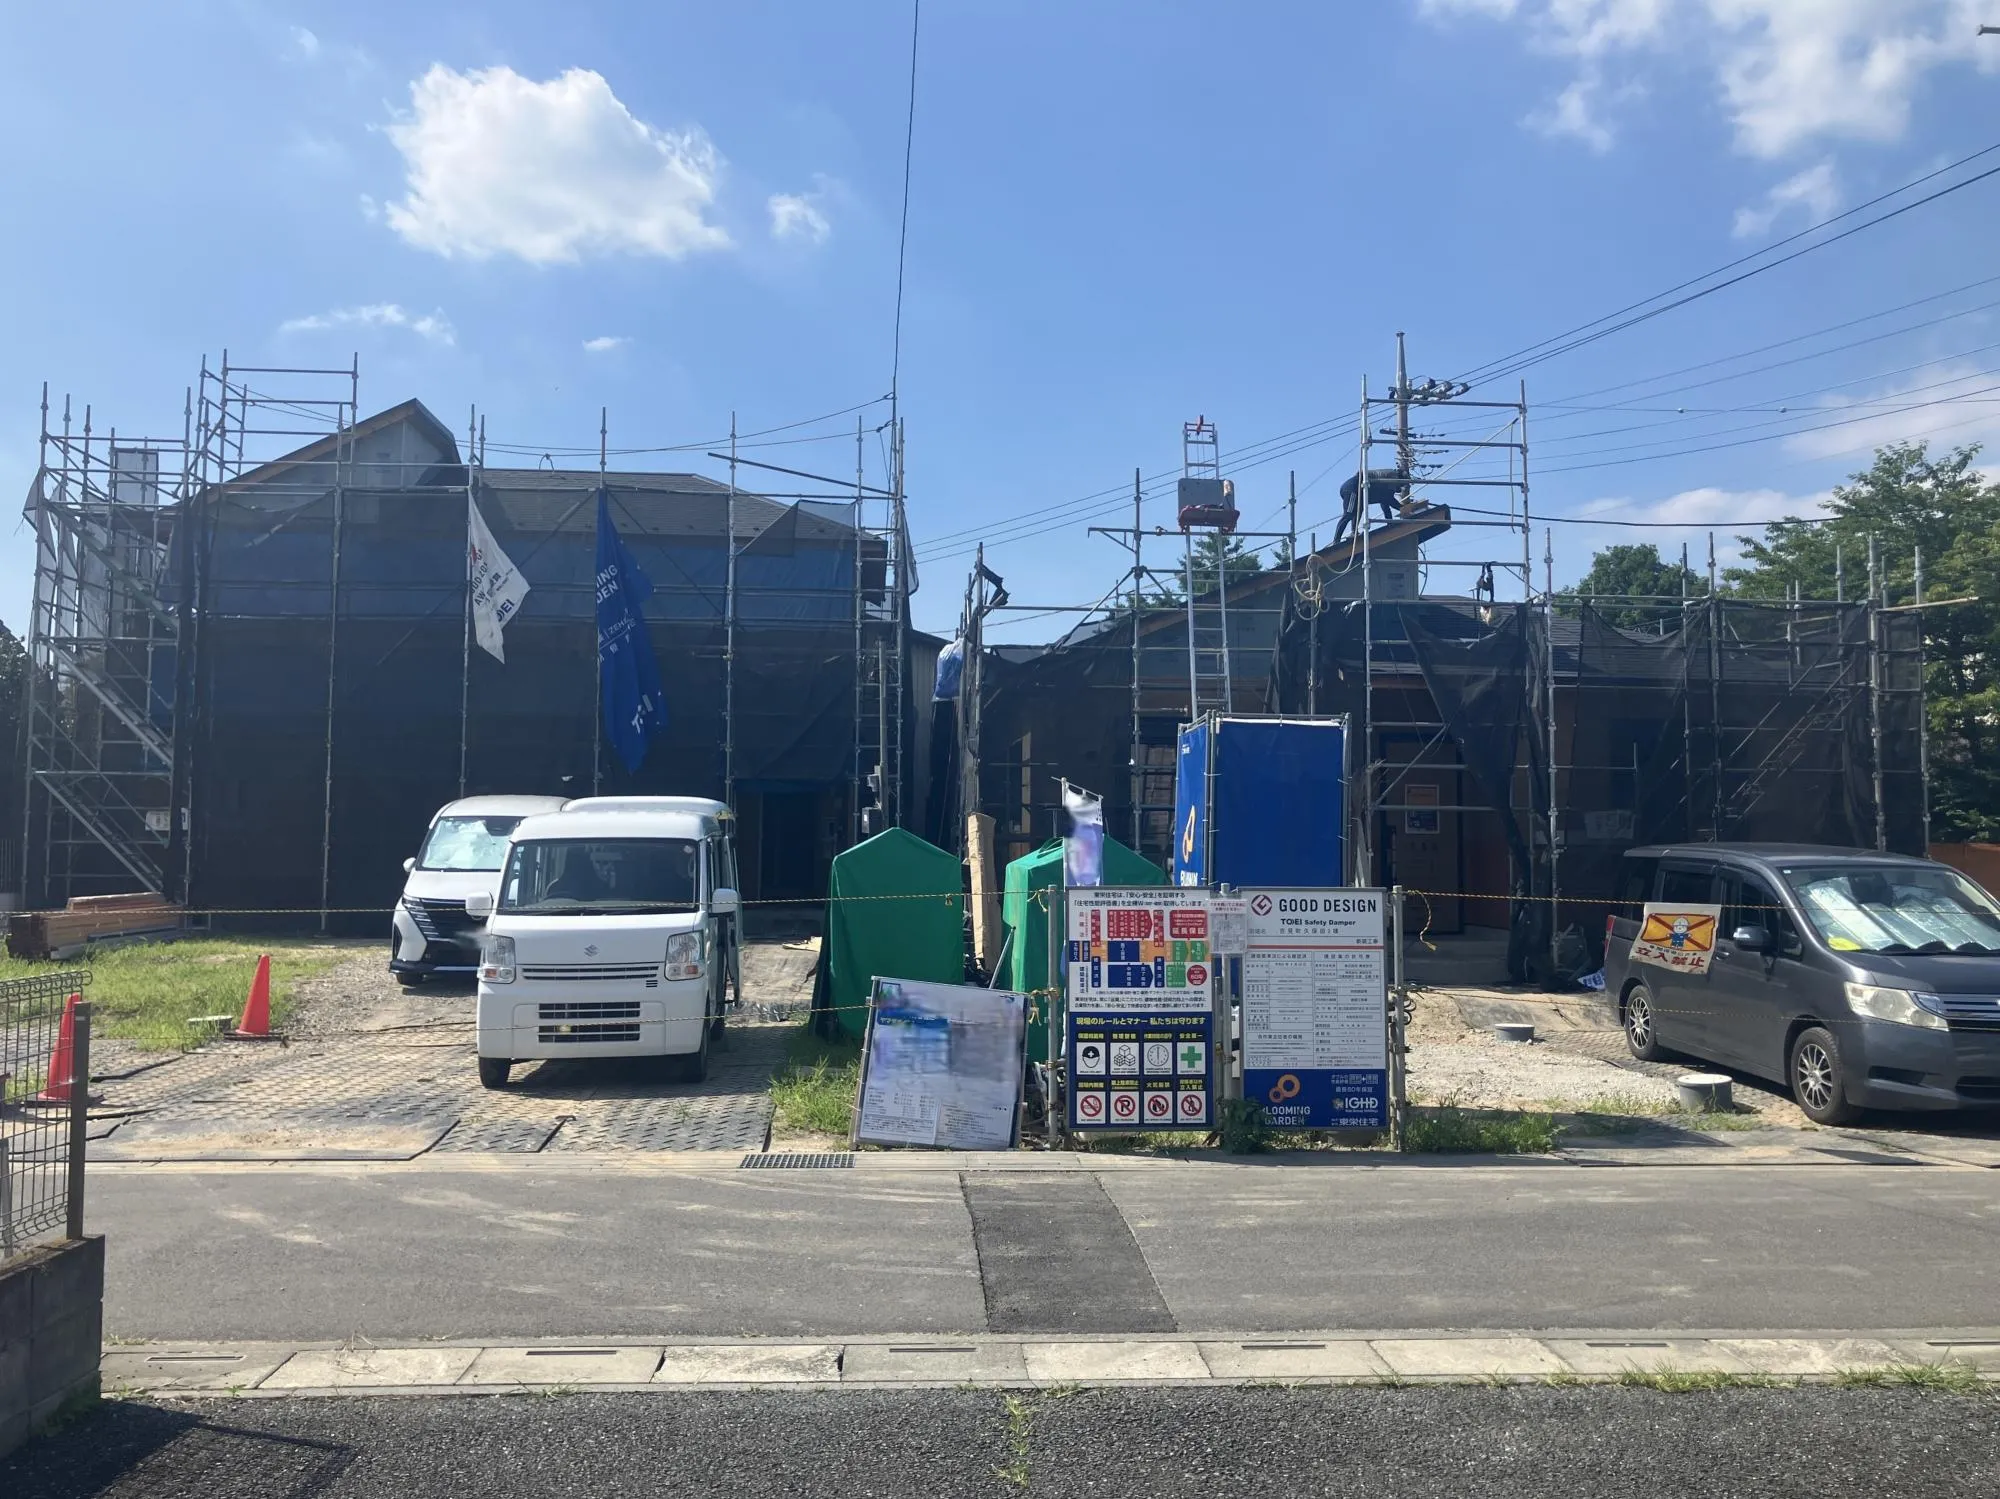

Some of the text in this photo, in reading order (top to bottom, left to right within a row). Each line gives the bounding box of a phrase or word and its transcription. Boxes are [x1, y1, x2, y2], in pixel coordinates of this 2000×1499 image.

[1279, 899, 1377, 913] GOOD DESIGN
[1635, 946, 1705, 968] 立入禁止
[1076, 1017, 1206, 1025] 現場のルールとマナー 私たちは守ります
[1262, 1106, 1311, 1115] LOOMING
